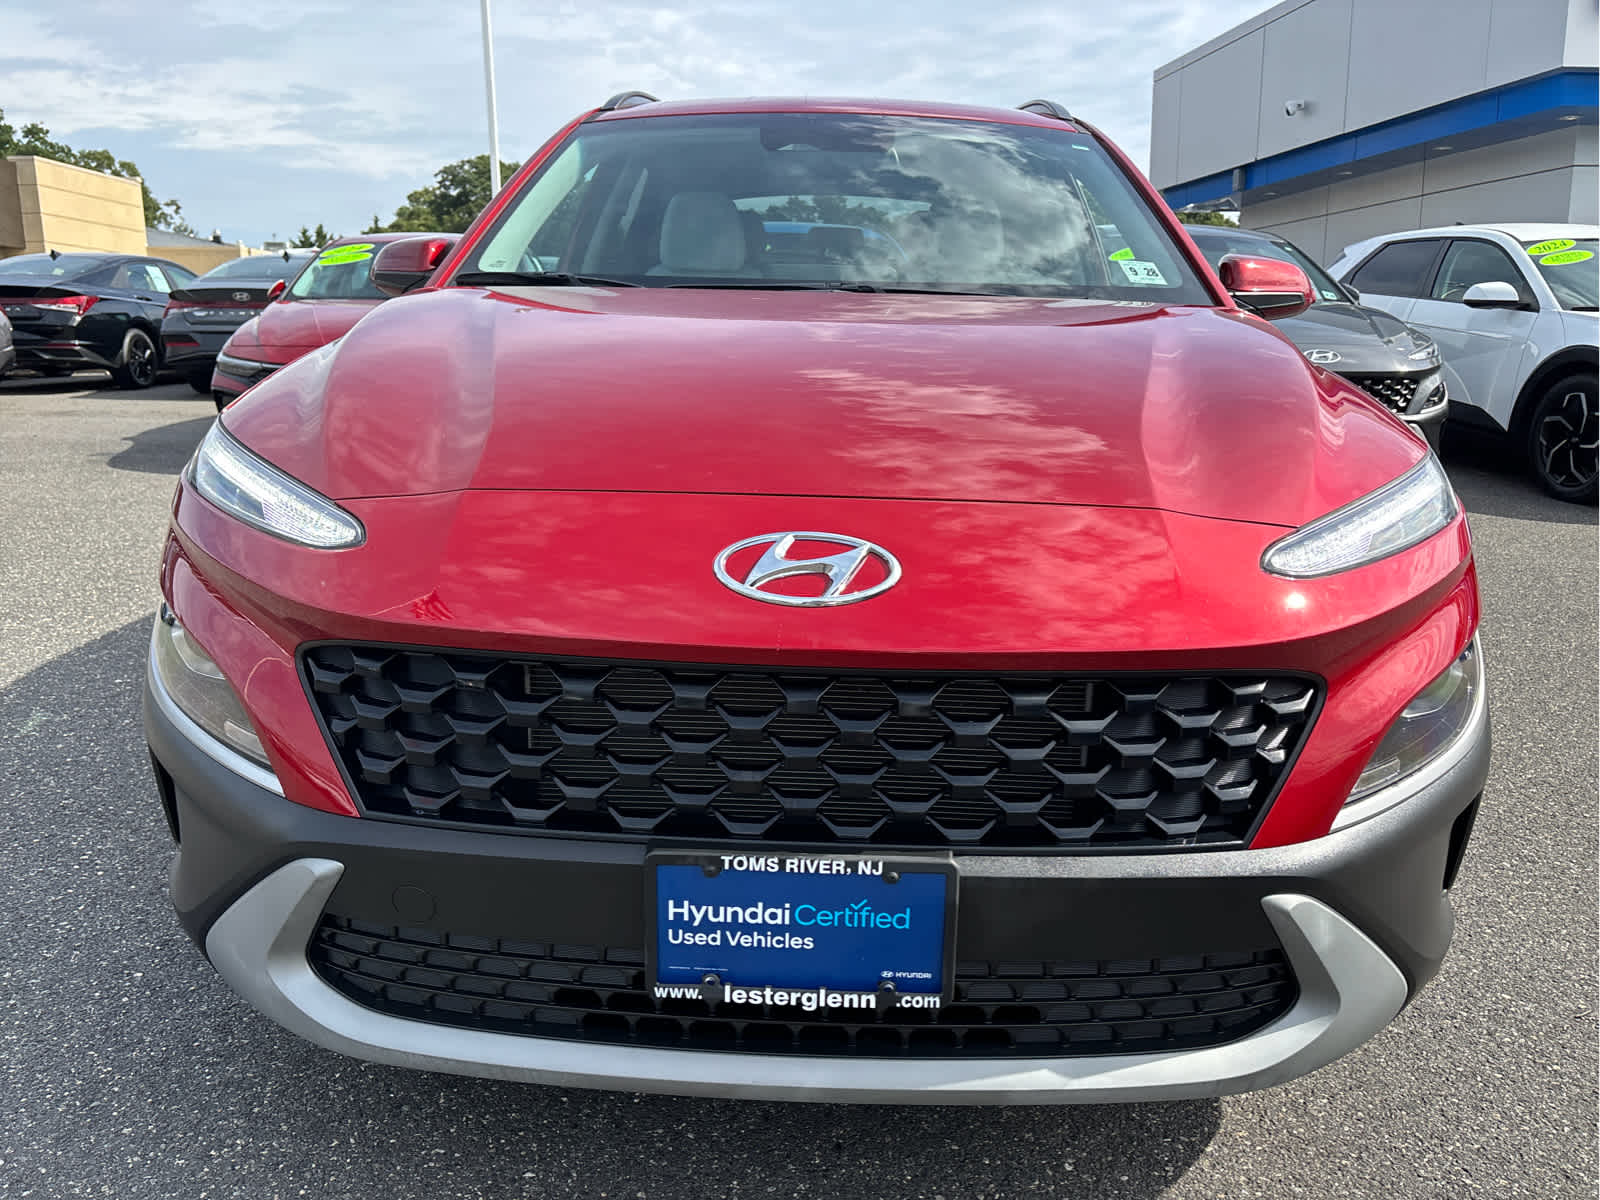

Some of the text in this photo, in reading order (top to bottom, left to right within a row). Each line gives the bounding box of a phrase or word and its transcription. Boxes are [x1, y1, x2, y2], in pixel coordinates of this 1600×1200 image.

[1535, 240, 1567, 253] 2024
[1128, 267, 1138, 276] 9
[720, 855, 883, 876] TOMS RIVER, NJ
[667, 899, 911, 930] Hyundai Certified
[668, 929, 814, 950] Used Vehicles
[895, 970, 932, 979] HYUNDAI
[654, 985, 941, 1011] www. lesterglenn .com
